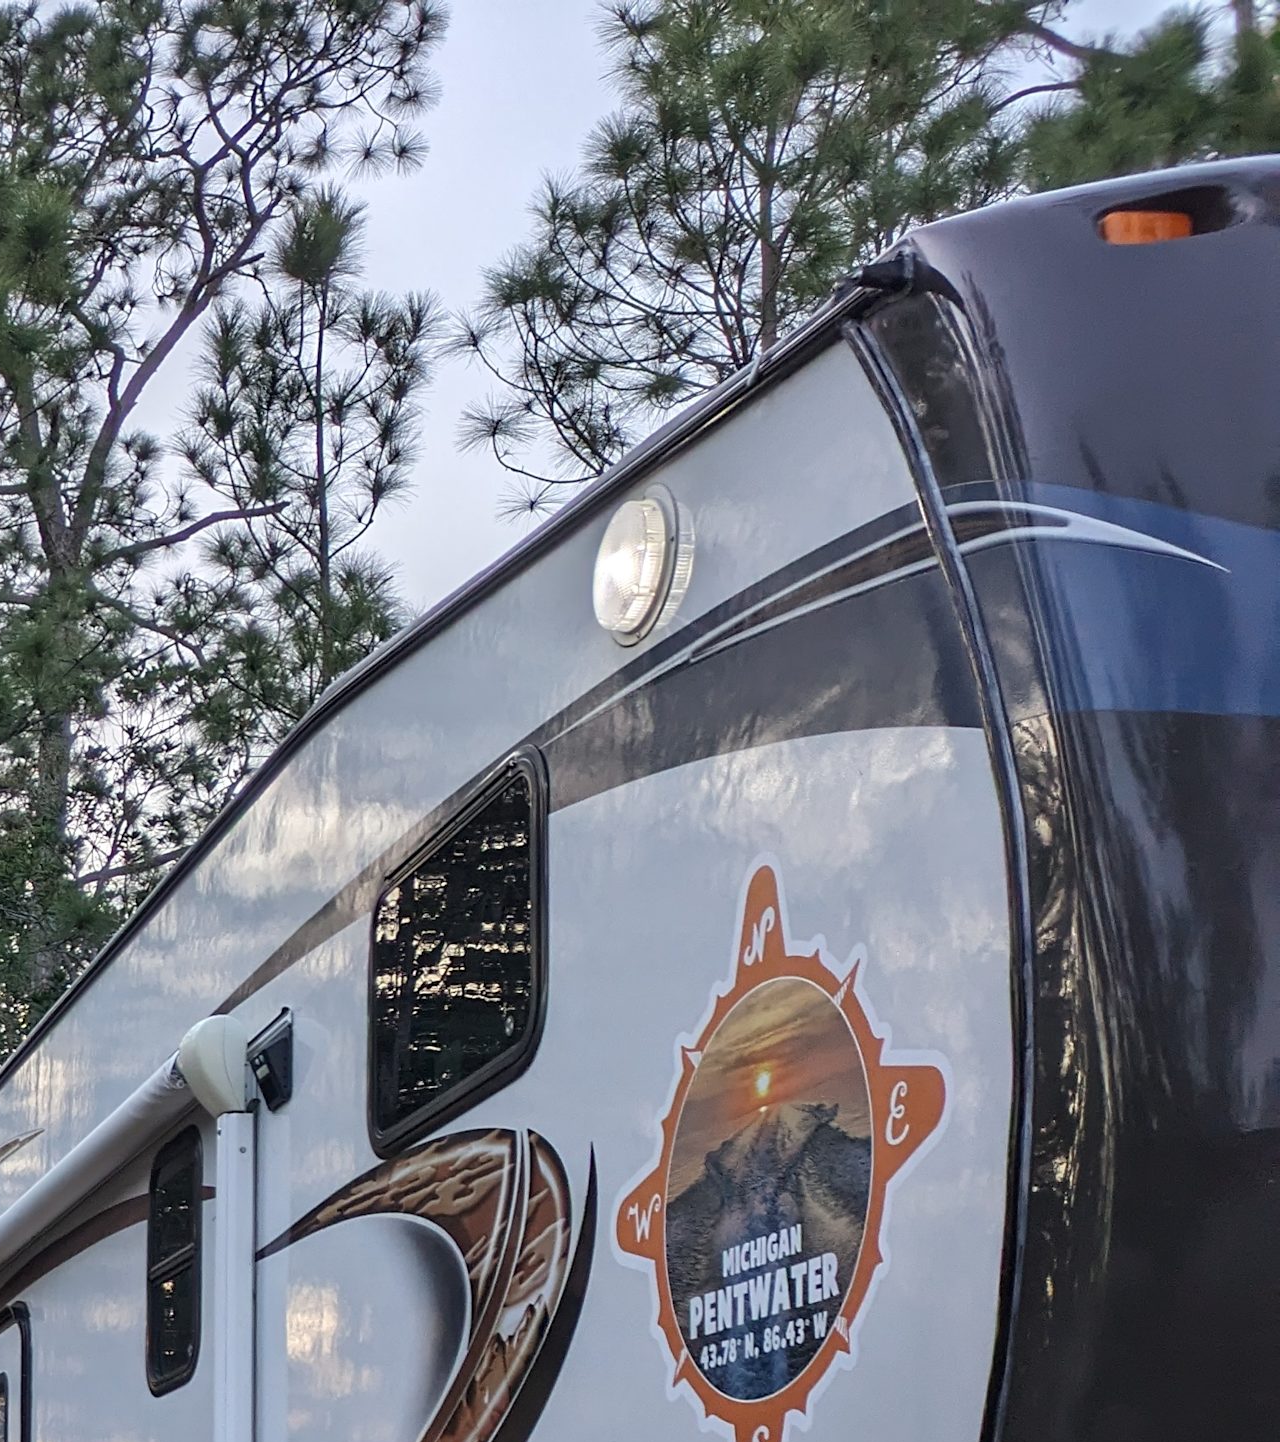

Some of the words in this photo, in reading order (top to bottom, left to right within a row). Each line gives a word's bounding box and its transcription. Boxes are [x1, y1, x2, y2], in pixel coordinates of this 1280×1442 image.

[744, 906, 775, 966] N
[886, 1081, 910, 1146] E
[627, 1193, 662, 1243] W
[722, 1224, 802, 1278] MICHIGAN
[690, 1252, 840, 1340] PENTWATER
[699, 1338, 742, 1371] 43.78°
[744, 1332, 760, 1360] N,
[763, 1318, 810, 1354] 86.43°
[813, 1311, 828, 1340] W
